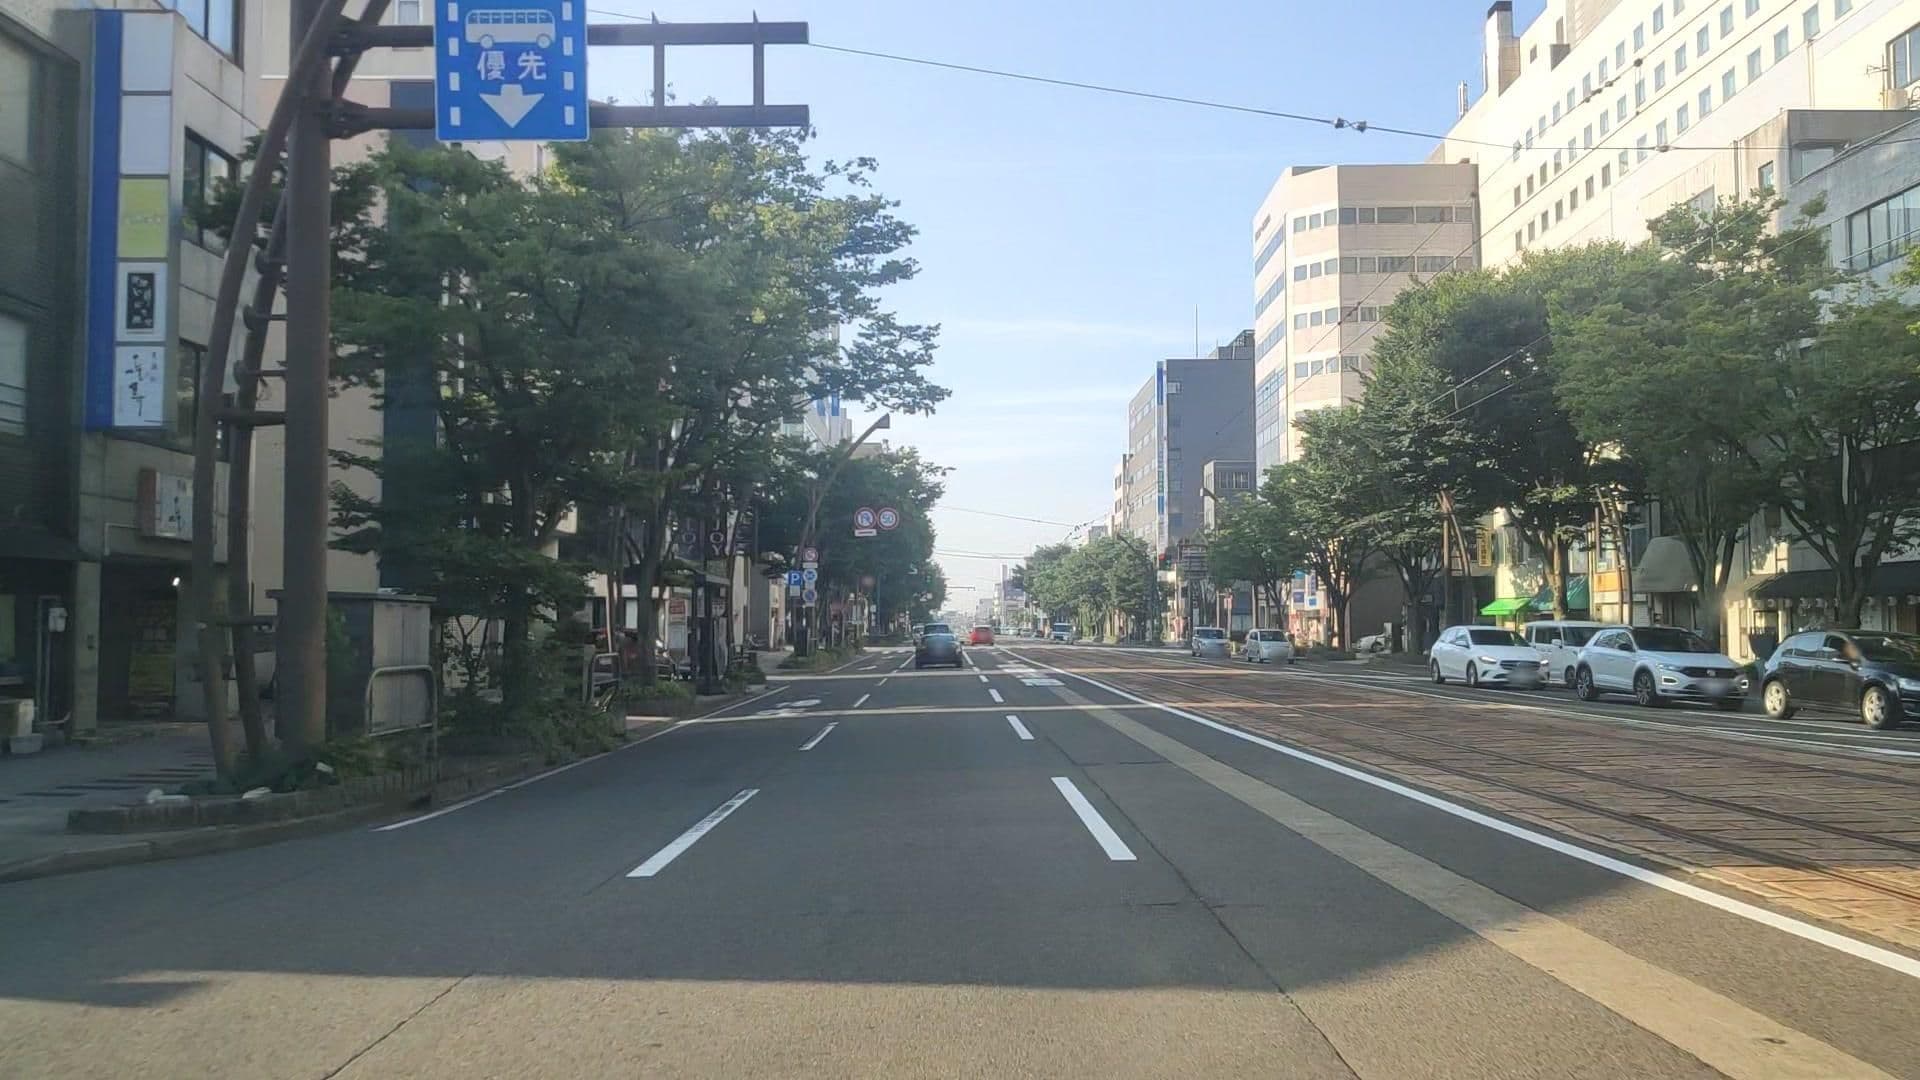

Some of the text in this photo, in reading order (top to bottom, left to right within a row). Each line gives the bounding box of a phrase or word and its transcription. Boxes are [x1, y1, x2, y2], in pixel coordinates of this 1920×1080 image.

[477, 50, 547, 80] 優先
[882, 513, 895, 524] 50
[791, 573, 800, 585] P
